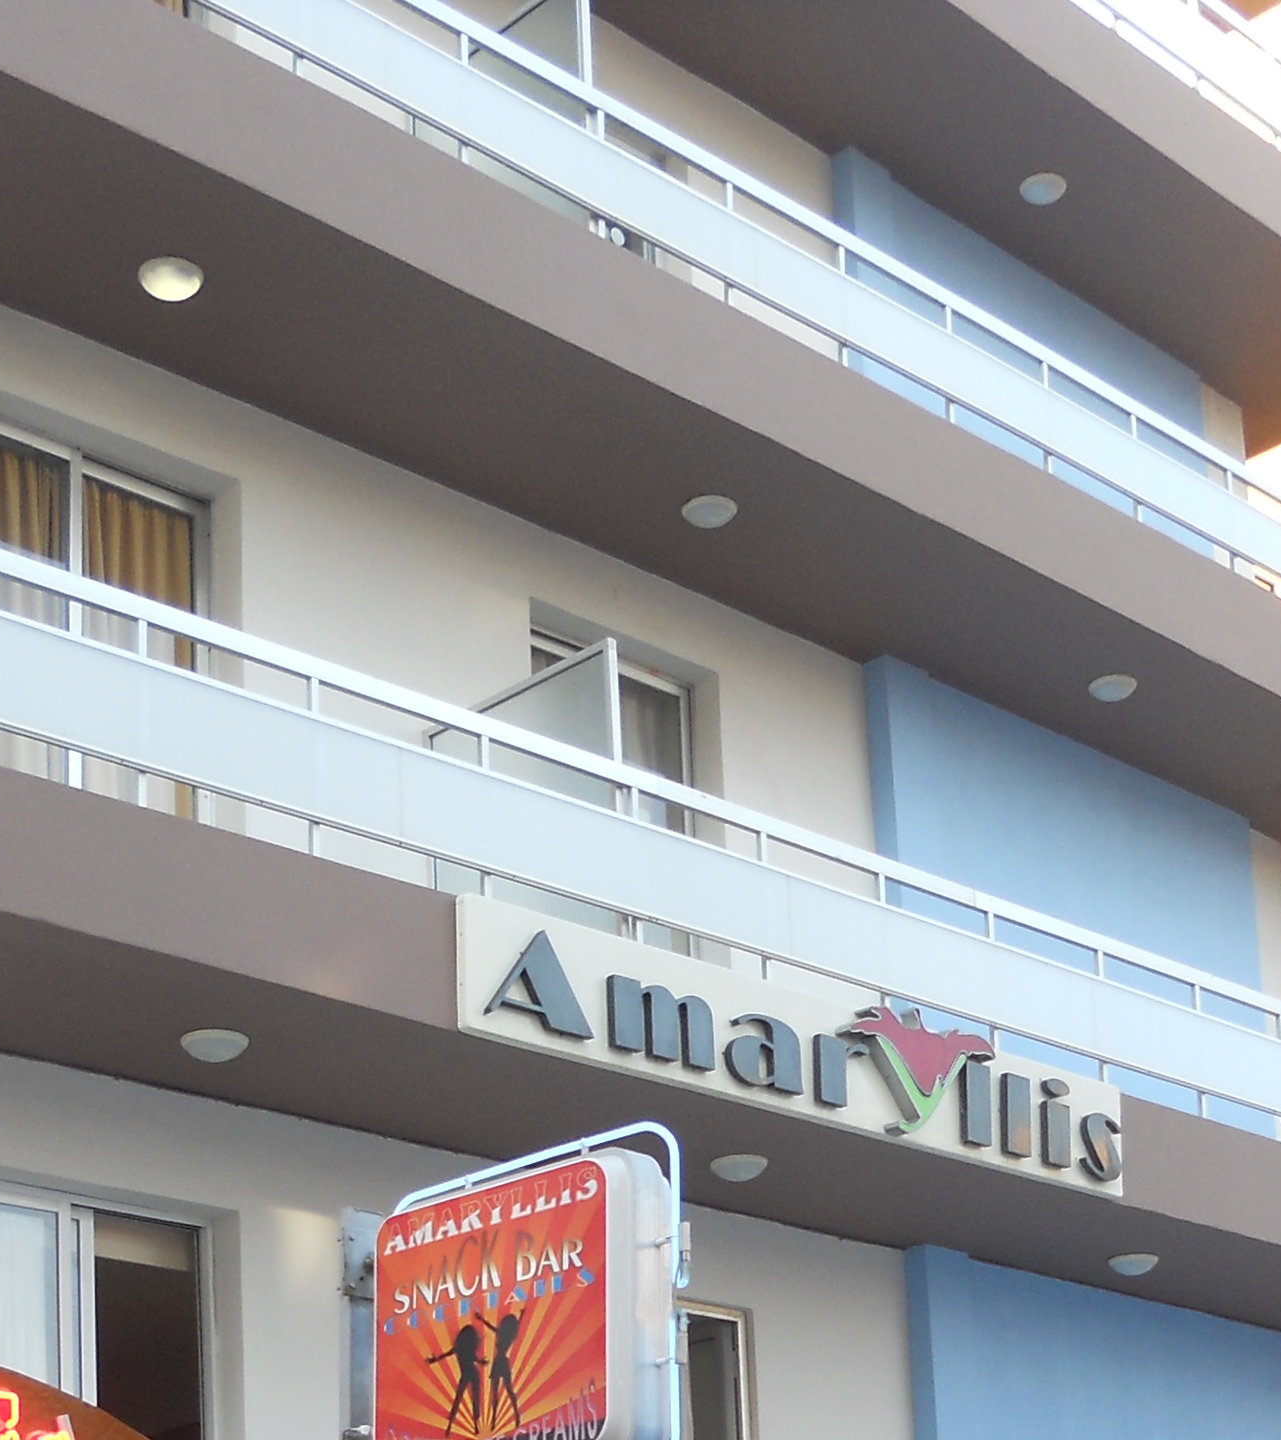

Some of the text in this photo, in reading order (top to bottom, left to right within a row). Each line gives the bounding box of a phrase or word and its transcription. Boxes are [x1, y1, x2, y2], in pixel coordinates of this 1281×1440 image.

[483, 928, 1122, 1182] Amaryllis
[384, 1166, 599, 1256] AMARYLLIS
[383, 1266, 597, 1336] COCKTAILS
[392, 1229, 585, 1315] SNACK BAR
